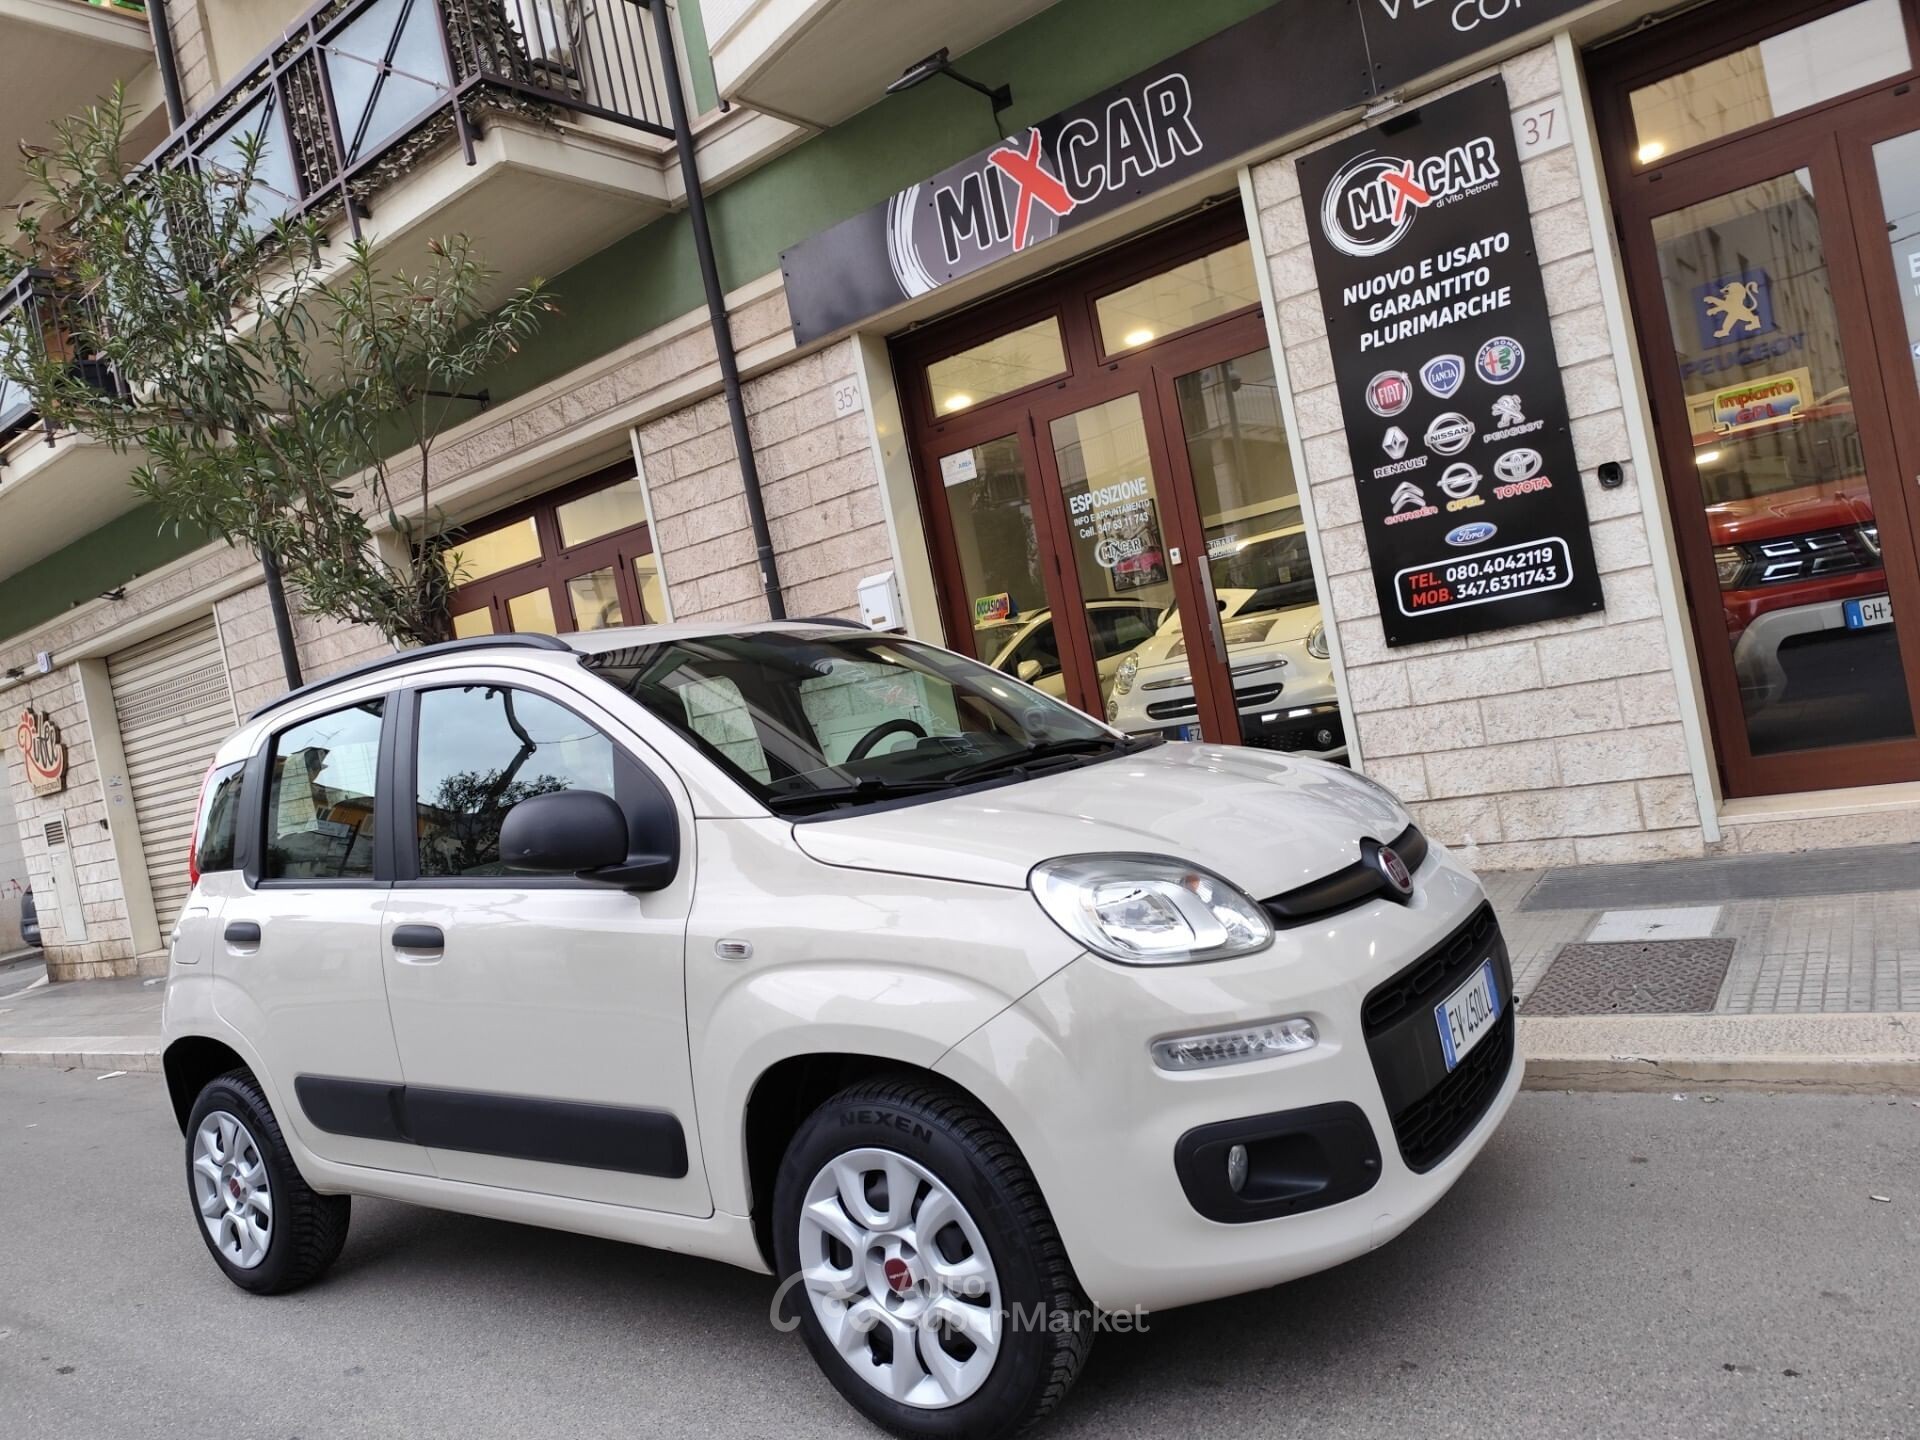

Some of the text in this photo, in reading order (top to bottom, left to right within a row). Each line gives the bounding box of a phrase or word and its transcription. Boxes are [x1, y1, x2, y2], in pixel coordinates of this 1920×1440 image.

[1522, 108, 1556, 146] 37
[934, 73, 1203, 264] MIXCAR
[1348, 136, 1500, 231] MIXCAR
[1436, 180, 1499, 208] di Vito Petrone
[1343, 232, 1509, 307] NUOVO E USATO
[1369, 266, 1490, 322] GARANTITO
[1360, 286, 1512, 352] PLURIMARCHE
[1493, 340, 1520, 356] ROMEO
[1679, 332, 1805, 379] PEUGEOT
[1431, 368, 1456, 383] LANCIA
[1377, 382, 1401, 406] FIAT
[1430, 426, 1469, 442] NISSAN
[1483, 420, 1544, 443] PEUGEOT
[1373, 456, 1428, 479] RENAULT
[1069, 477, 1149, 515] ESPOSIZIONE
[1493, 475, 1552, 500] TOYOTA
[1073, 515, 1090, 527] INFO
[1095, 499, 1150, 521] APPUNTAMENTO
[1446, 495, 1486, 512] OPEL
[1097, 521, 1112, 535] 347
[1112, 519, 1123, 529] 63
[1125, 516, 1134, 527] 11
[1134, 512, 1149, 524] 743
[1456, 528, 1486, 543] Ford
[1408, 547, 1553, 589] TEL. 080.4042119
[1412, 566, 1556, 608] MOB. 347.6311743
[840, 1110, 933, 1145] NEXEN
